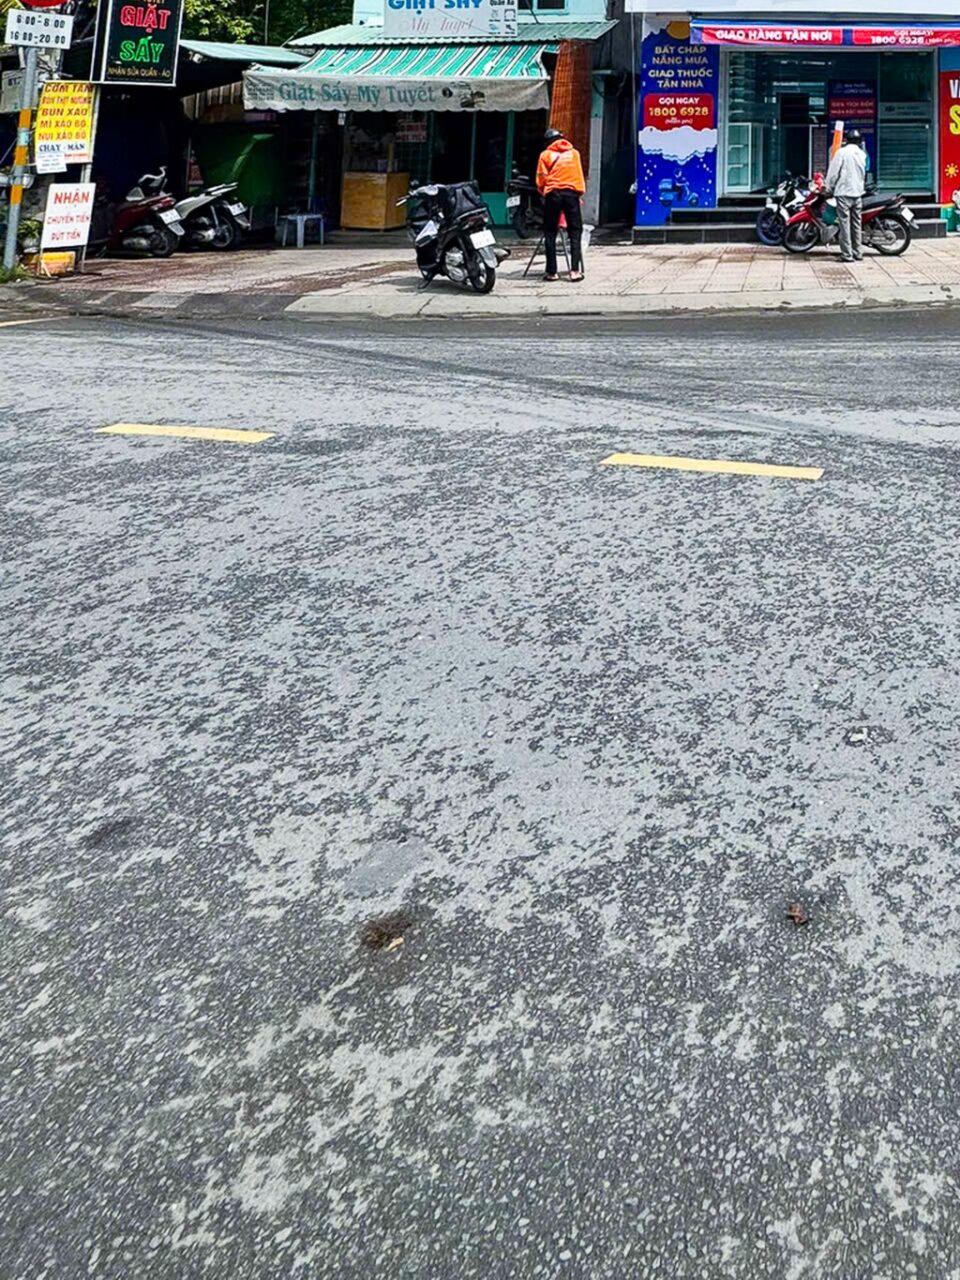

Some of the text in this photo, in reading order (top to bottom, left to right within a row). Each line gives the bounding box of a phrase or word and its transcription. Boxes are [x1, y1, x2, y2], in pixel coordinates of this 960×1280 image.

[120, 3, 171, 33] GIẶT
[715, 28, 833, 45] GIAO HÀNG TẬN NƠI
[870, 35, 896, 44] 1800
[120, 36, 165, 63] SẤY
[655, 44, 707, 54] BẤT CHẤP
[652, 54, 708, 65] NẮNG MƯA
[648, 67, 713, 78] GIAO THUỐC
[657, 78, 704, 90] TẬN NHÀ
[386, 81, 436, 107] Tuyết
[659, 97, 699, 106] GỌI NGAY
[649, 106, 709, 117] 1800 6928
[54, 188, 90, 207] NHẬN
